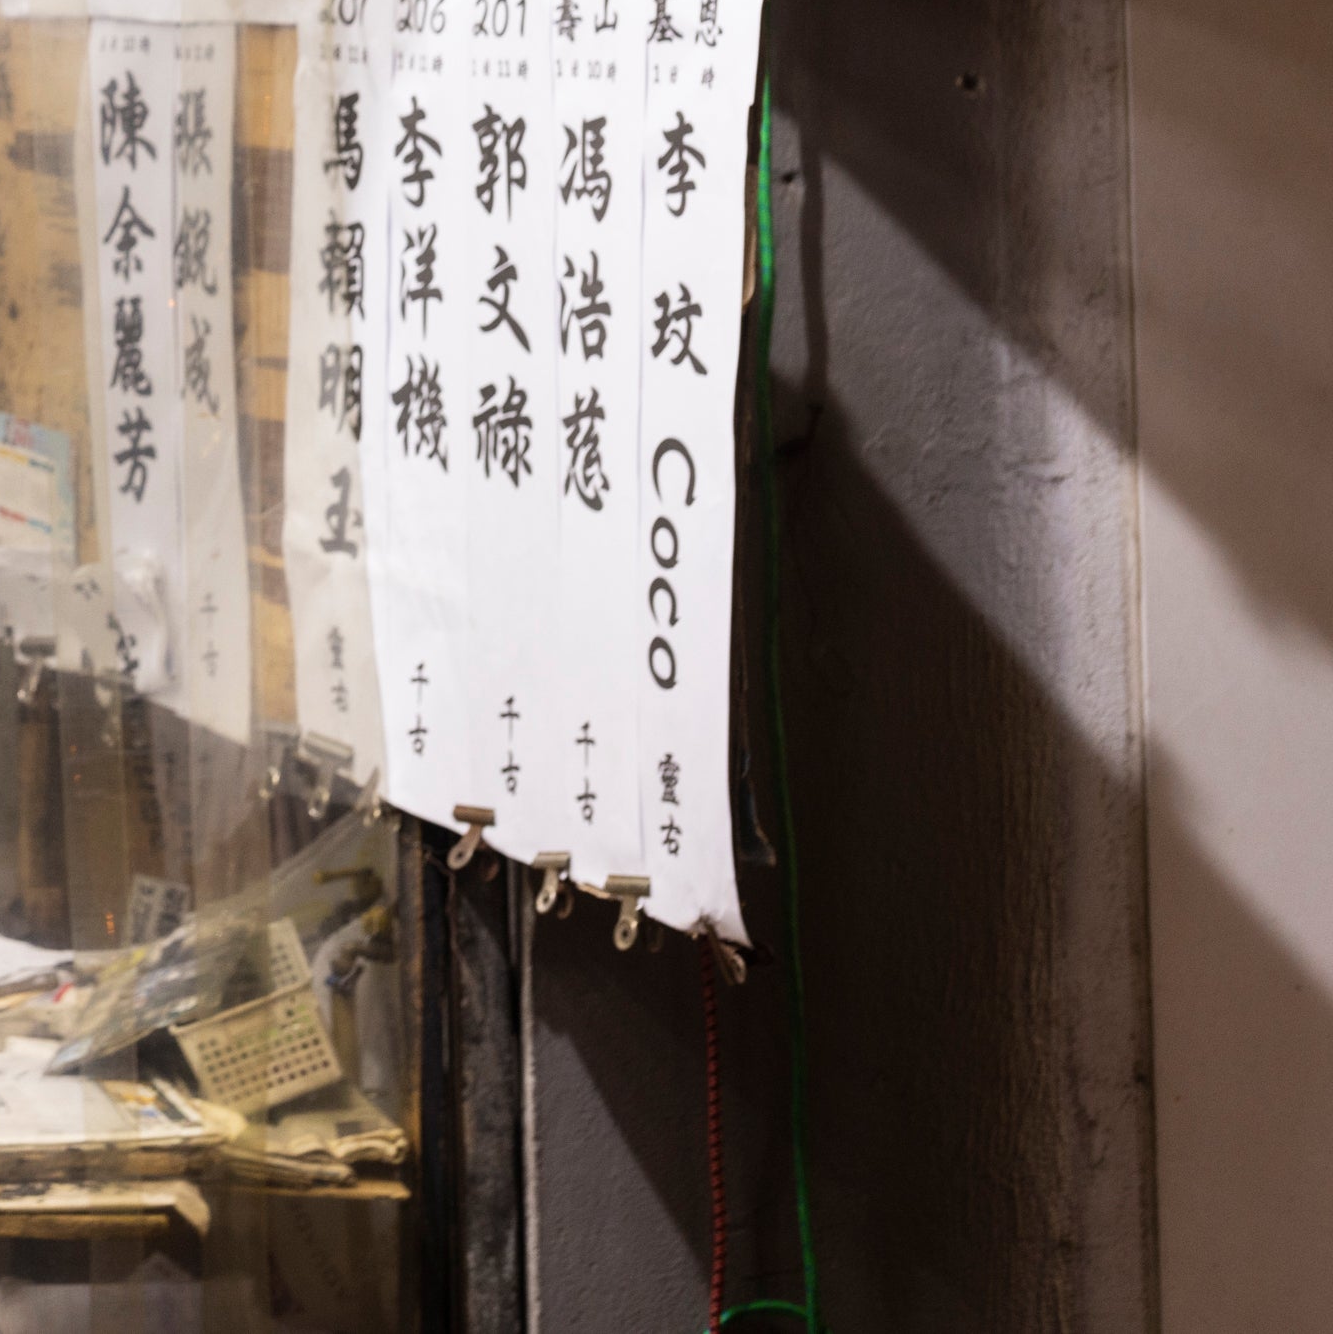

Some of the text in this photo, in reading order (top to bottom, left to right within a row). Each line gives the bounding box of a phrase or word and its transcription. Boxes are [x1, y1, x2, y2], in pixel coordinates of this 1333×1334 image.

[98, 69, 158, 504] 陳余麗芳
[391, 95, 449, 474] 李洋機
[558, 116, 612, 512] 馮浩慈
[650, 110, 708, 375] 李玟
[407, 661, 430, 757] 千古
[498, 695, 521, 798] 千古
[573, 721, 597, 825] 千古
